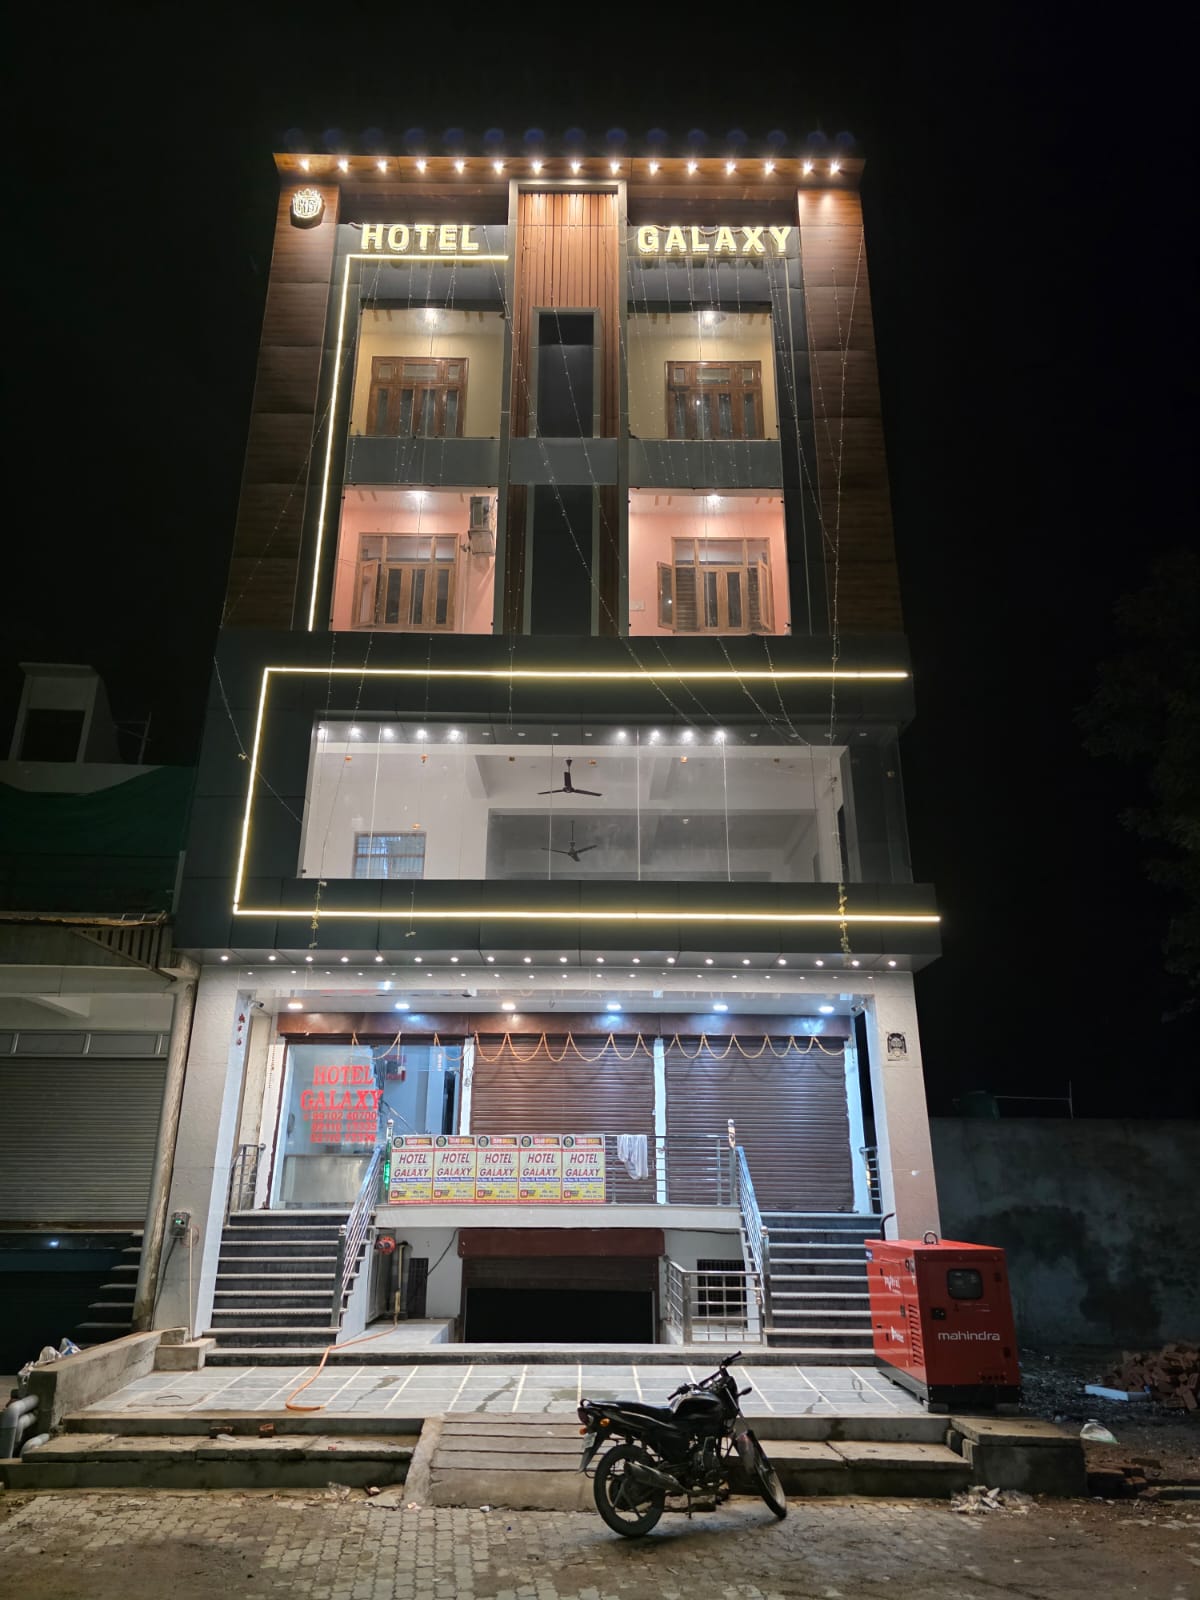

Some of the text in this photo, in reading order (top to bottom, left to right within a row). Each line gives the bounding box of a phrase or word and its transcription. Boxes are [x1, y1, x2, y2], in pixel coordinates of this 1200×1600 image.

[360, 223, 792, 254] HOTEL GALAXY
[312, 1065, 375, 1086] HOTEL
[300, 1089, 384, 1111] GALAXY
[398, 1153, 427, 1164] HOTEL
[441, 1152, 470, 1164] HOTEL
[484, 1153, 512, 1164] HOTEL
[527, 1153, 555, 1164] HOTEL
[569, 1153, 598, 1164] HOTEL
[394, 1168, 429, 1178] GALAXY
[437, 1167, 472, 1177] GALAXY
[480, 1168, 515, 1177] GALAXY
[522, 1168, 558, 1177] GALAXY
[565, 1168, 600, 1177] GALAXY
[937, 1330, 1001, 1341] mahindra
